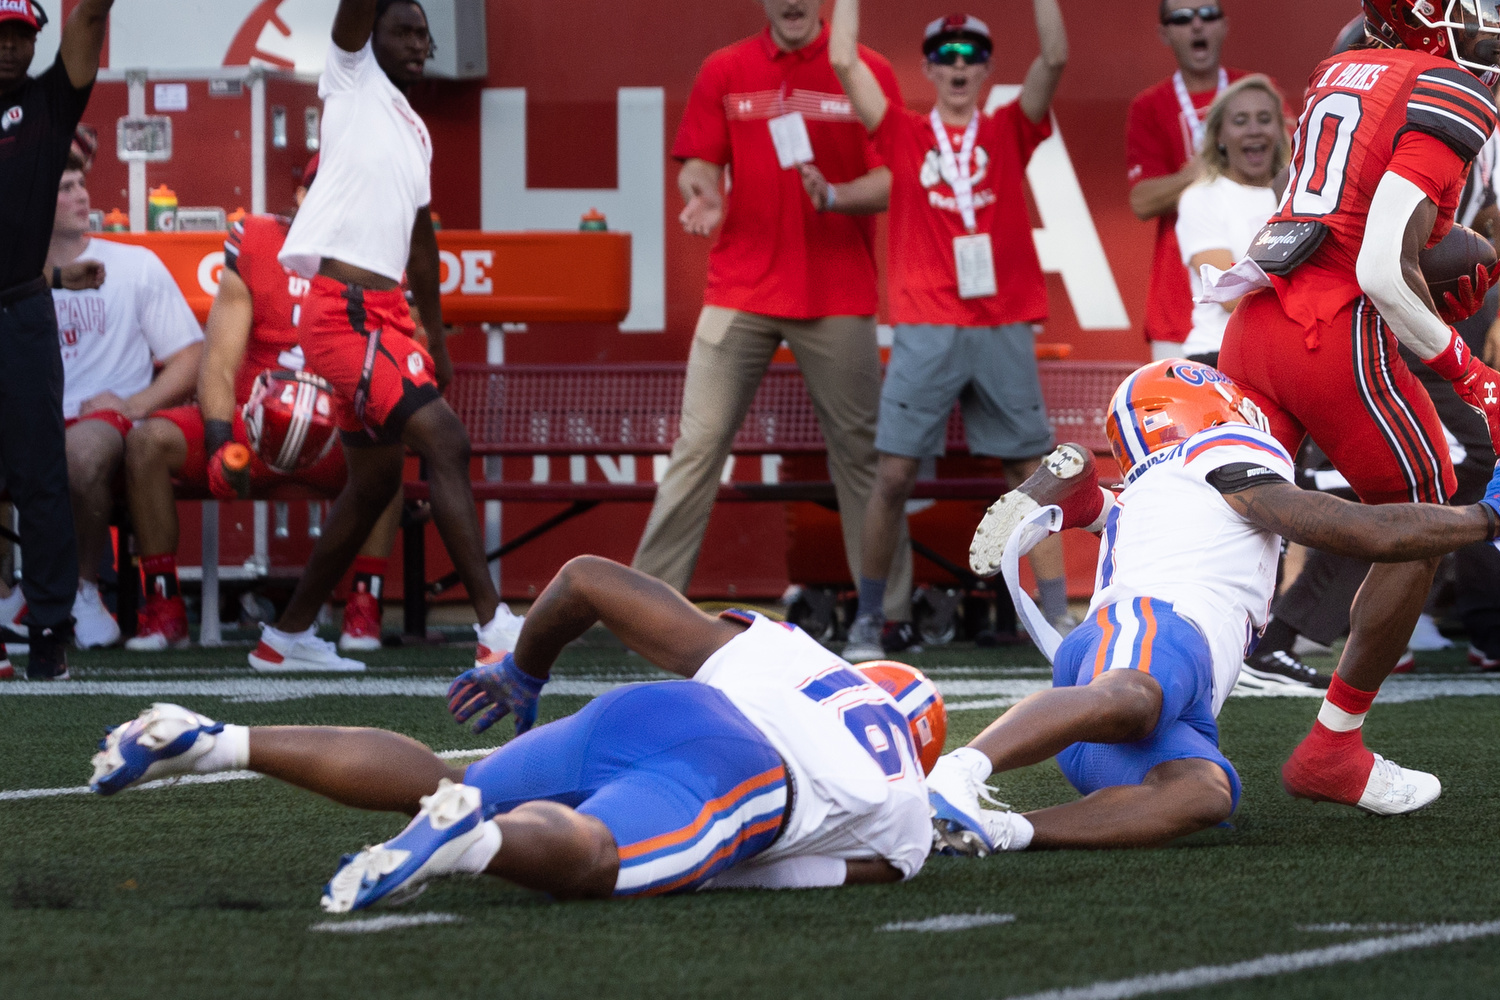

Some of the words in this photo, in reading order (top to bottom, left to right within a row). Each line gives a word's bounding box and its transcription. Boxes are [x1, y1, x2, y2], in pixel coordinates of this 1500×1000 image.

[1330, 62, 1389, 91] PARKS
[1255, 230, 1300, 250] Douglas
[55, 298, 105, 335] TAH
